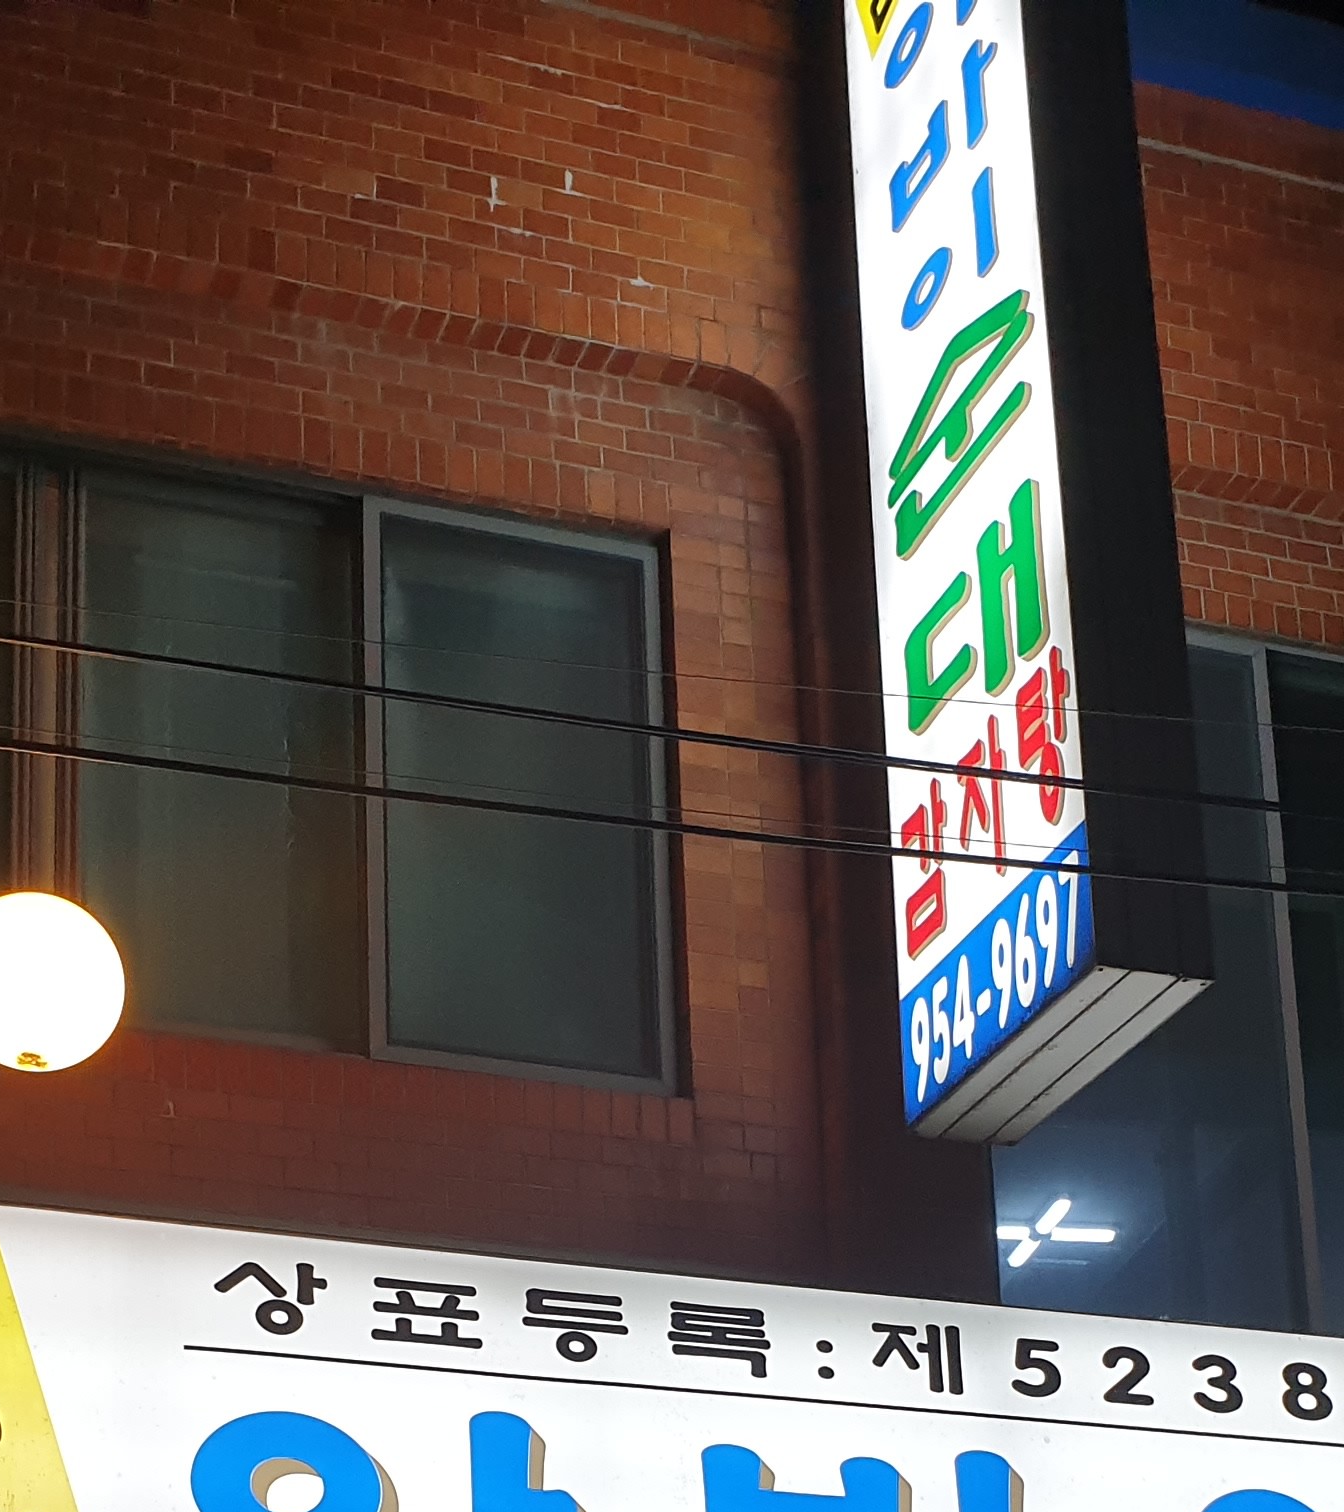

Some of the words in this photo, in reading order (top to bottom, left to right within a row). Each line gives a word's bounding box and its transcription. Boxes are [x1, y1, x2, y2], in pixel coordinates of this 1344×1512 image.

[888, 289, 1051, 736] 순대
[900, 646, 1069, 960] 감자탕
[910, 849, 1080, 1103] 954-9697
